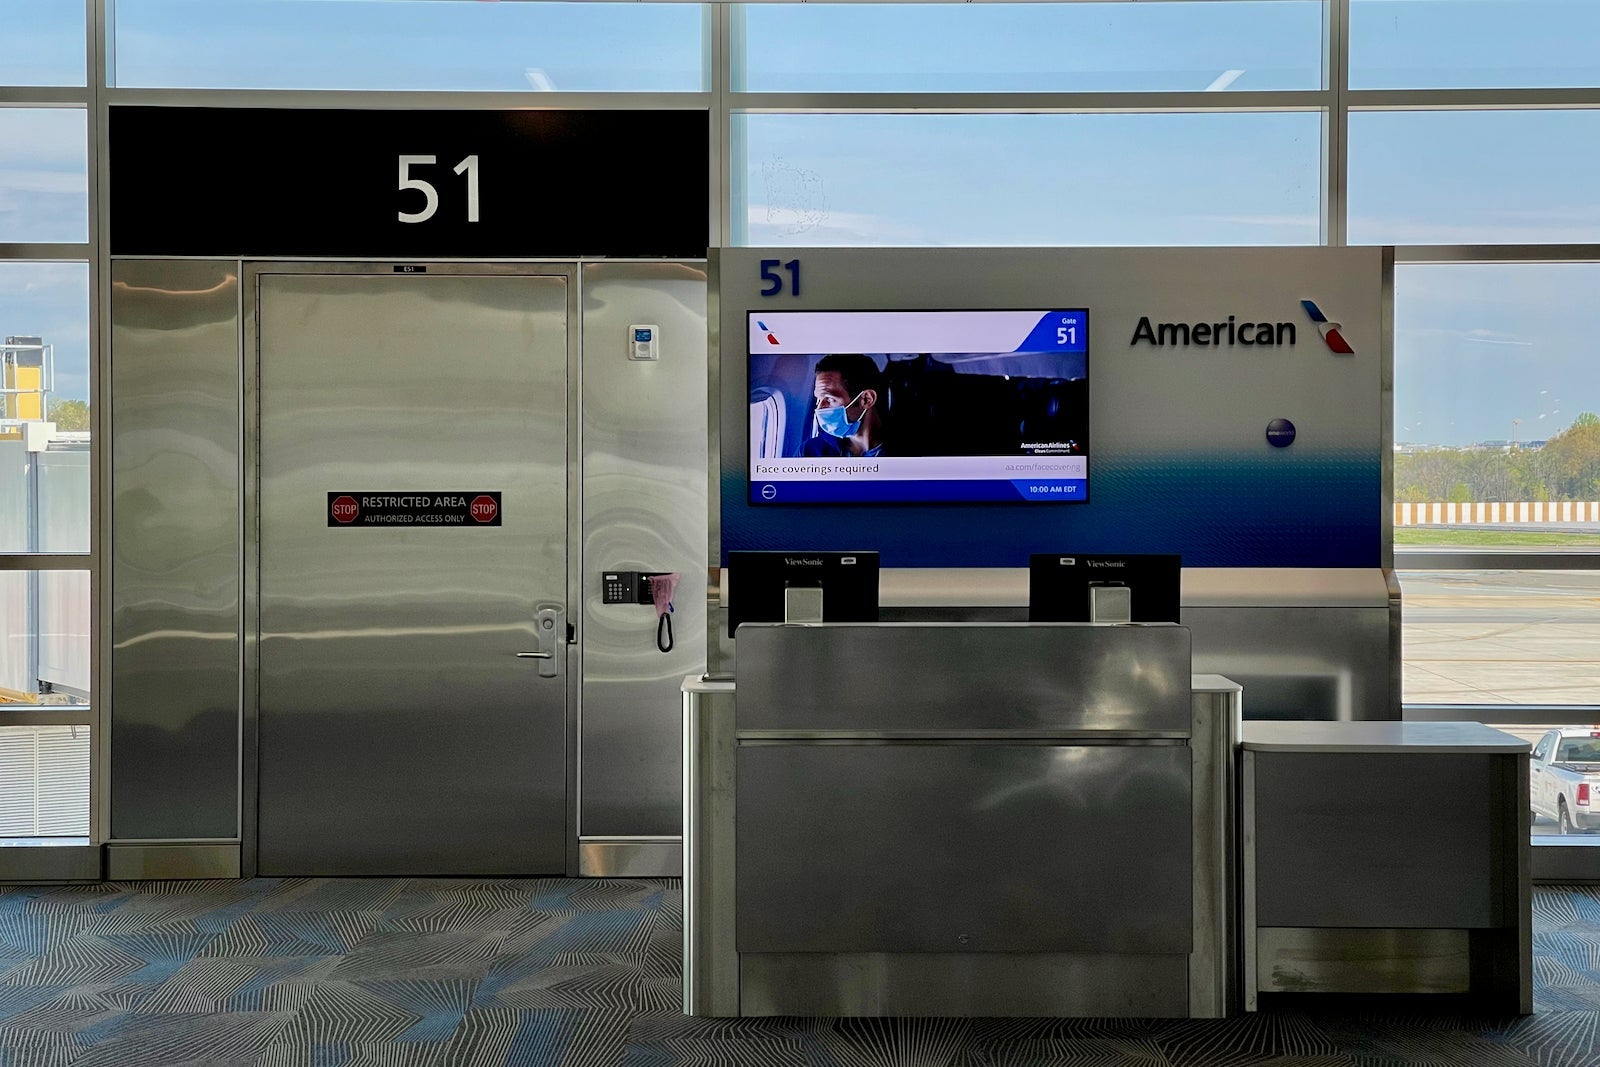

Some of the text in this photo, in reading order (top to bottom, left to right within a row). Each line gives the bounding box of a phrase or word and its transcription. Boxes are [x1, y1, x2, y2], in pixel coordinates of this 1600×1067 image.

[398, 154, 479, 223] 51
[760, 259, 800, 296] 51
[1061, 317, 1077, 325] Gate
[1057, 326, 1076, 345] 51
[1130, 315, 1296, 346] American
[756, 464, 879, 475] Face coverings required
[1030, 485, 1077, 493] 10:00 AM EDT
[362, 496, 467, 508] RESTRICTED AREA
[333, 504, 357, 515] STOP
[472, 503, 496, 515] STOP
[364, 514, 465, 523] AUTHORIZED ACCESS ONLY
[784, 557, 823, 566] ViewSonic
[1086, 559, 1126, 568] ViewSonic
